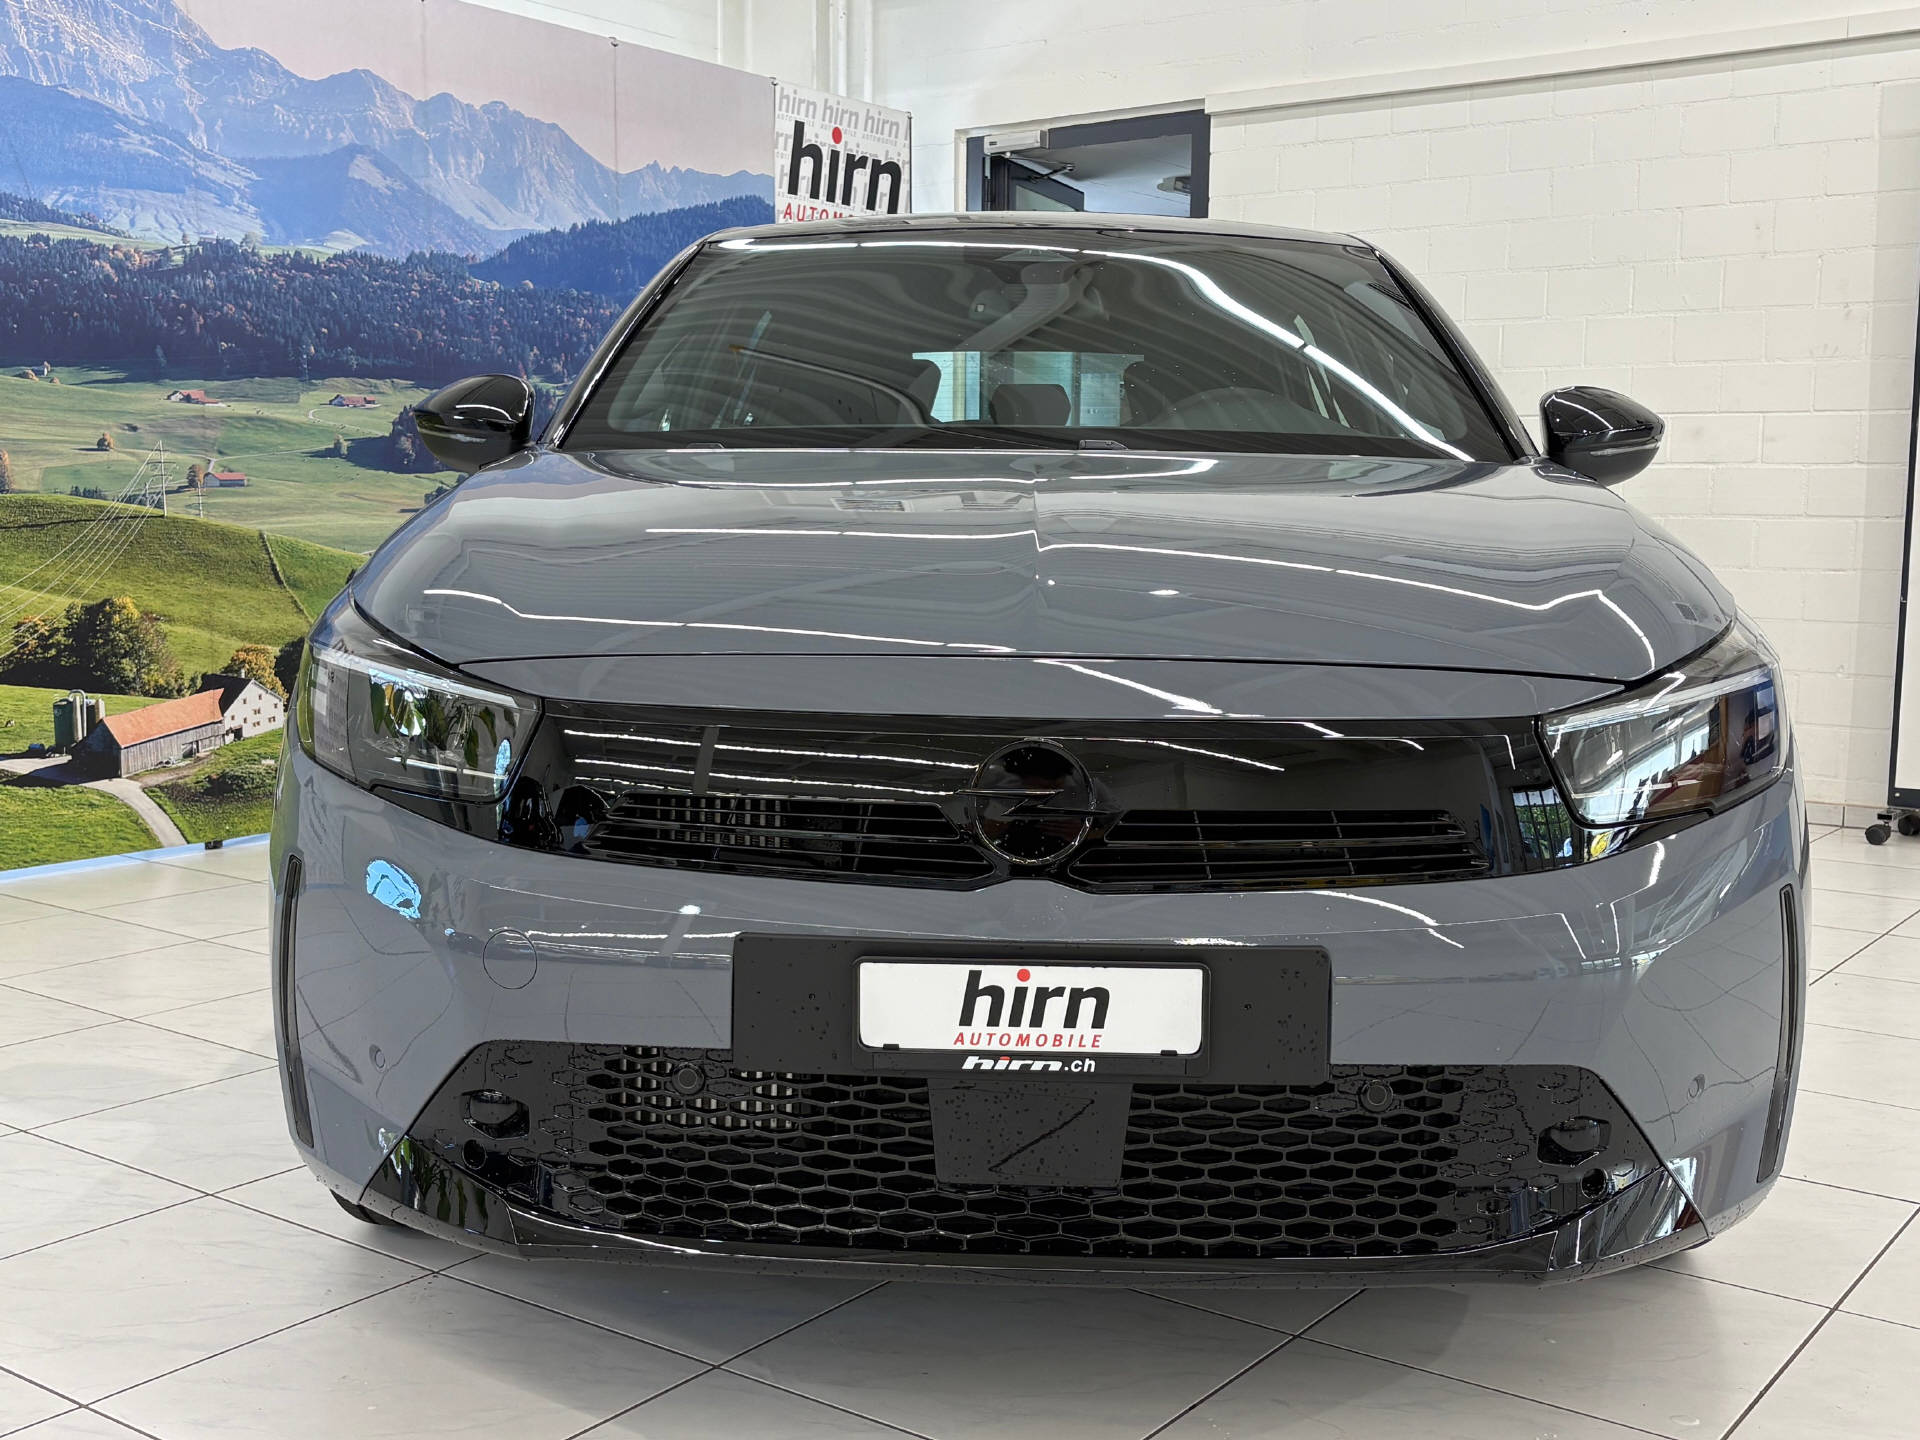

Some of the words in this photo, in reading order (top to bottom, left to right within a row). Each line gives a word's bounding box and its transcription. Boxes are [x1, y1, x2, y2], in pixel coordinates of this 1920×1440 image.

[778, 86, 817, 120] hirn
[822, 98, 859, 130] hirn
[864, 108, 900, 139] hirn
[787, 119, 902, 214] hirn
[783, 202, 855, 222] AUTO
[958, 968, 1110, 1029] hirn
[953, 1031, 1102, 1048] AUTOMOBILE
[961, 1055, 1096, 1073] hirn.ch
